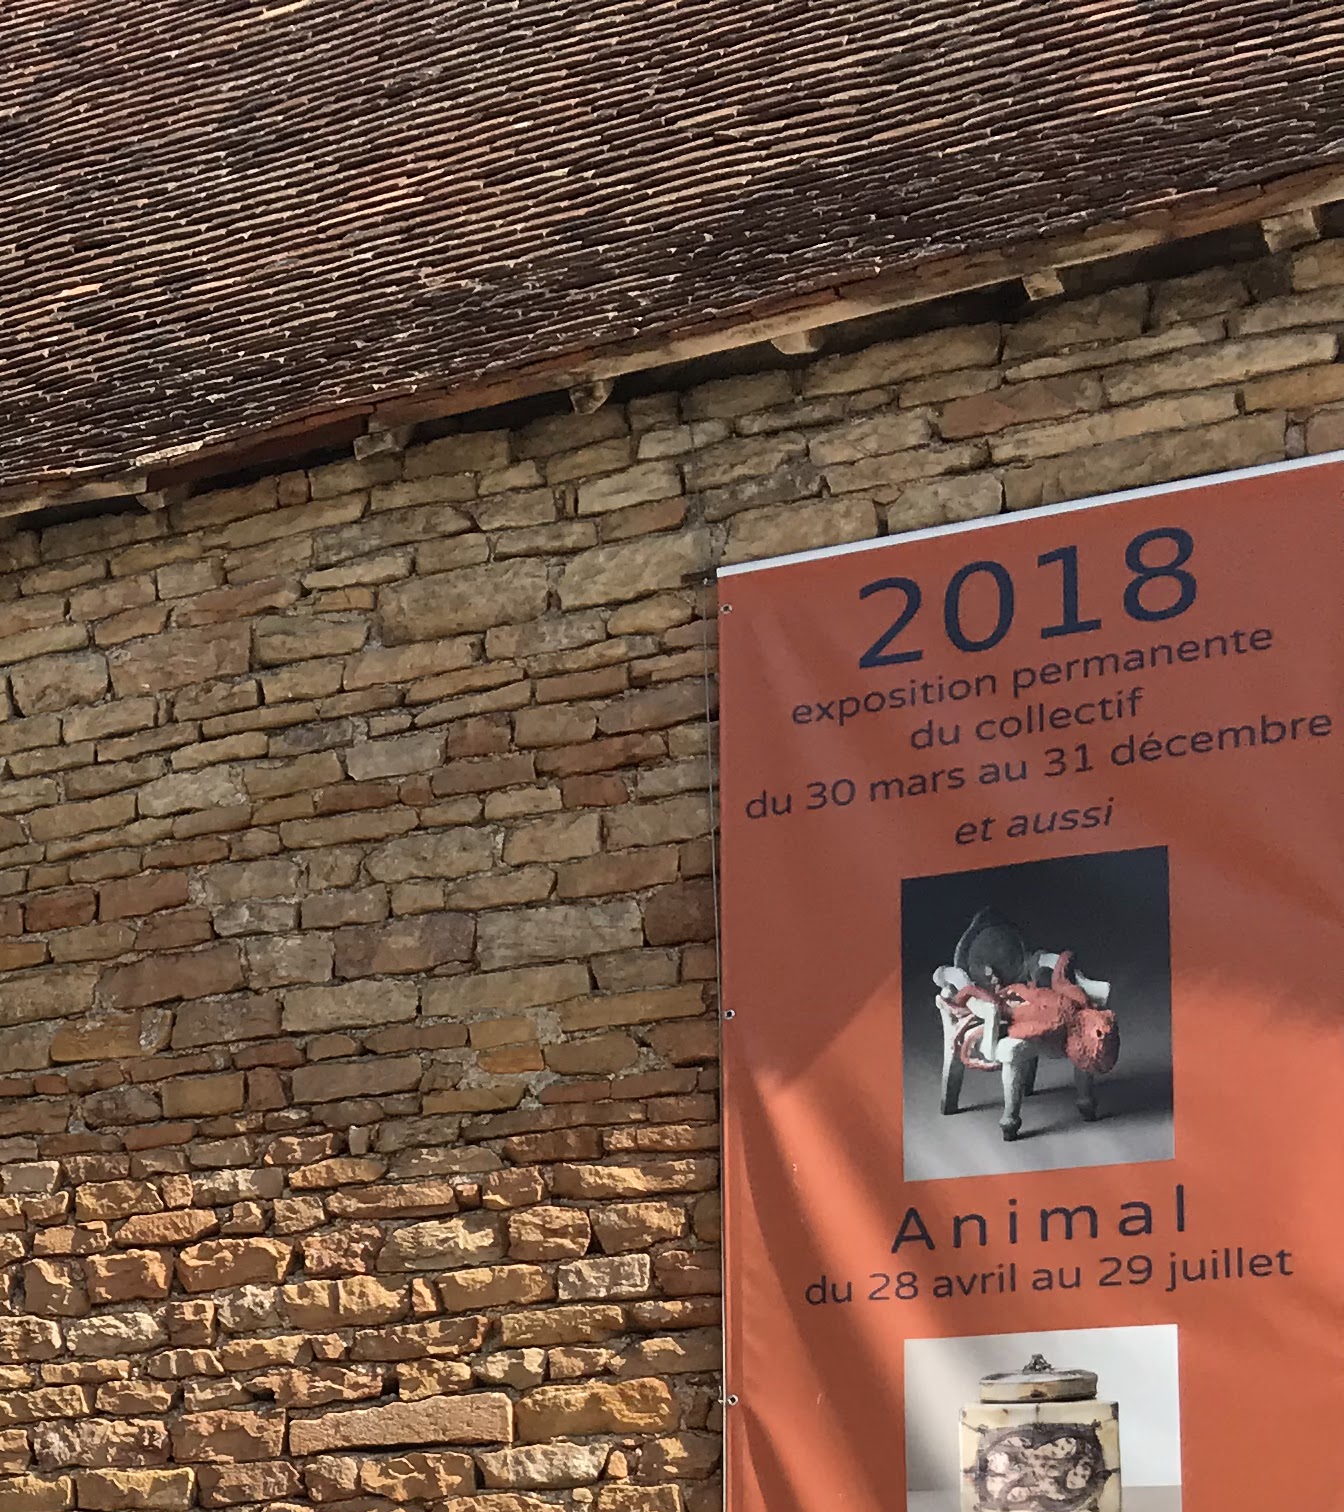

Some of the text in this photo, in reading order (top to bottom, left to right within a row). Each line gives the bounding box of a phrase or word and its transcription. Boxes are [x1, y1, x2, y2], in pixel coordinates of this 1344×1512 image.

[858, 526, 1198, 670] 2018
[792, 624, 1274, 727] exposition permanente
[910, 686, 1145, 751] du collectif
[744, 709, 1333, 820] du 30 mars au 31 décembre
[954, 797, 1115, 847] et aussi
[891, 1183, 1187, 1254] Animal
[804, 1247, 1294, 1306] du 28 avril au 29 juillet
